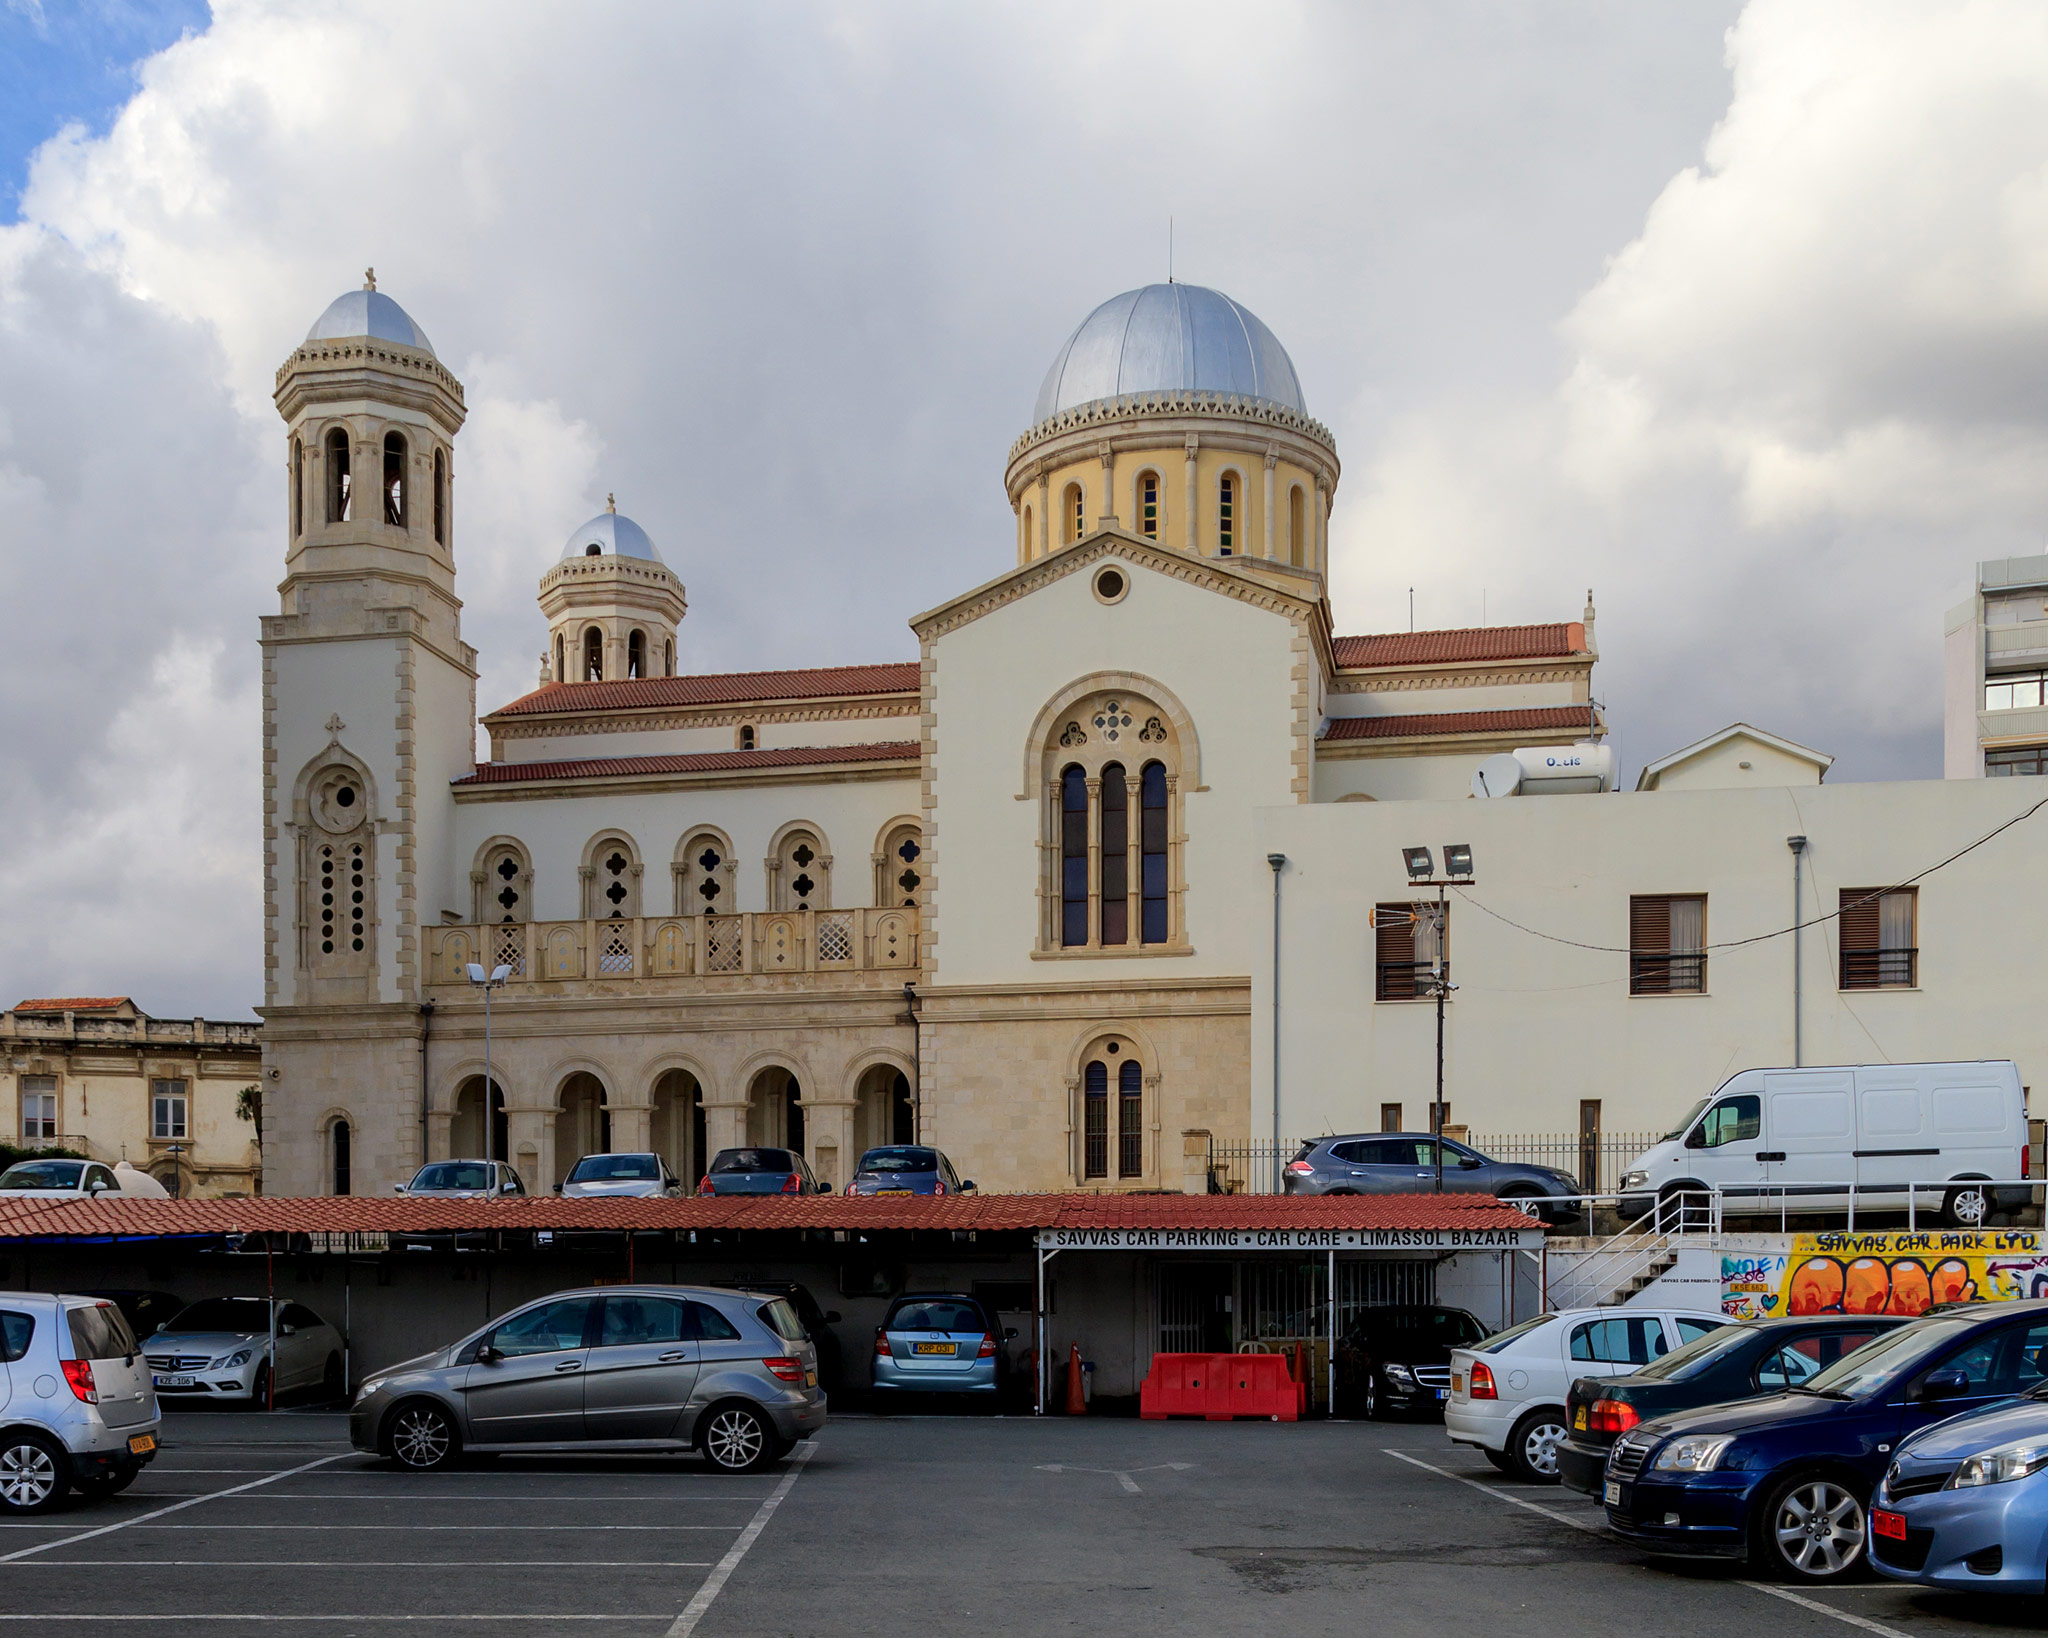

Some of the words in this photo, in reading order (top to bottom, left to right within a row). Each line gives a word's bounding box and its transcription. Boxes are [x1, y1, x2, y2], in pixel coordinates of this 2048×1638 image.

[1056, 1231, 1120, 1246] SAVVAS
[1126, 1231, 1160, 1246] CAR
[1165, 1231, 1239, 1246] PARKING
[1256, 1231, 1291, 1246] CAR
[1297, 1231, 1341, 1246] CARE
[1360, 1231, 1444, 1246] LIMASSOL
[1451, 1231, 1519, 1246] BAZAAR
[1941, 1233, 1987, 1250] PARK
[918, 1344, 935, 1352] KRP
[936, 1344, 950, 1352] 031
